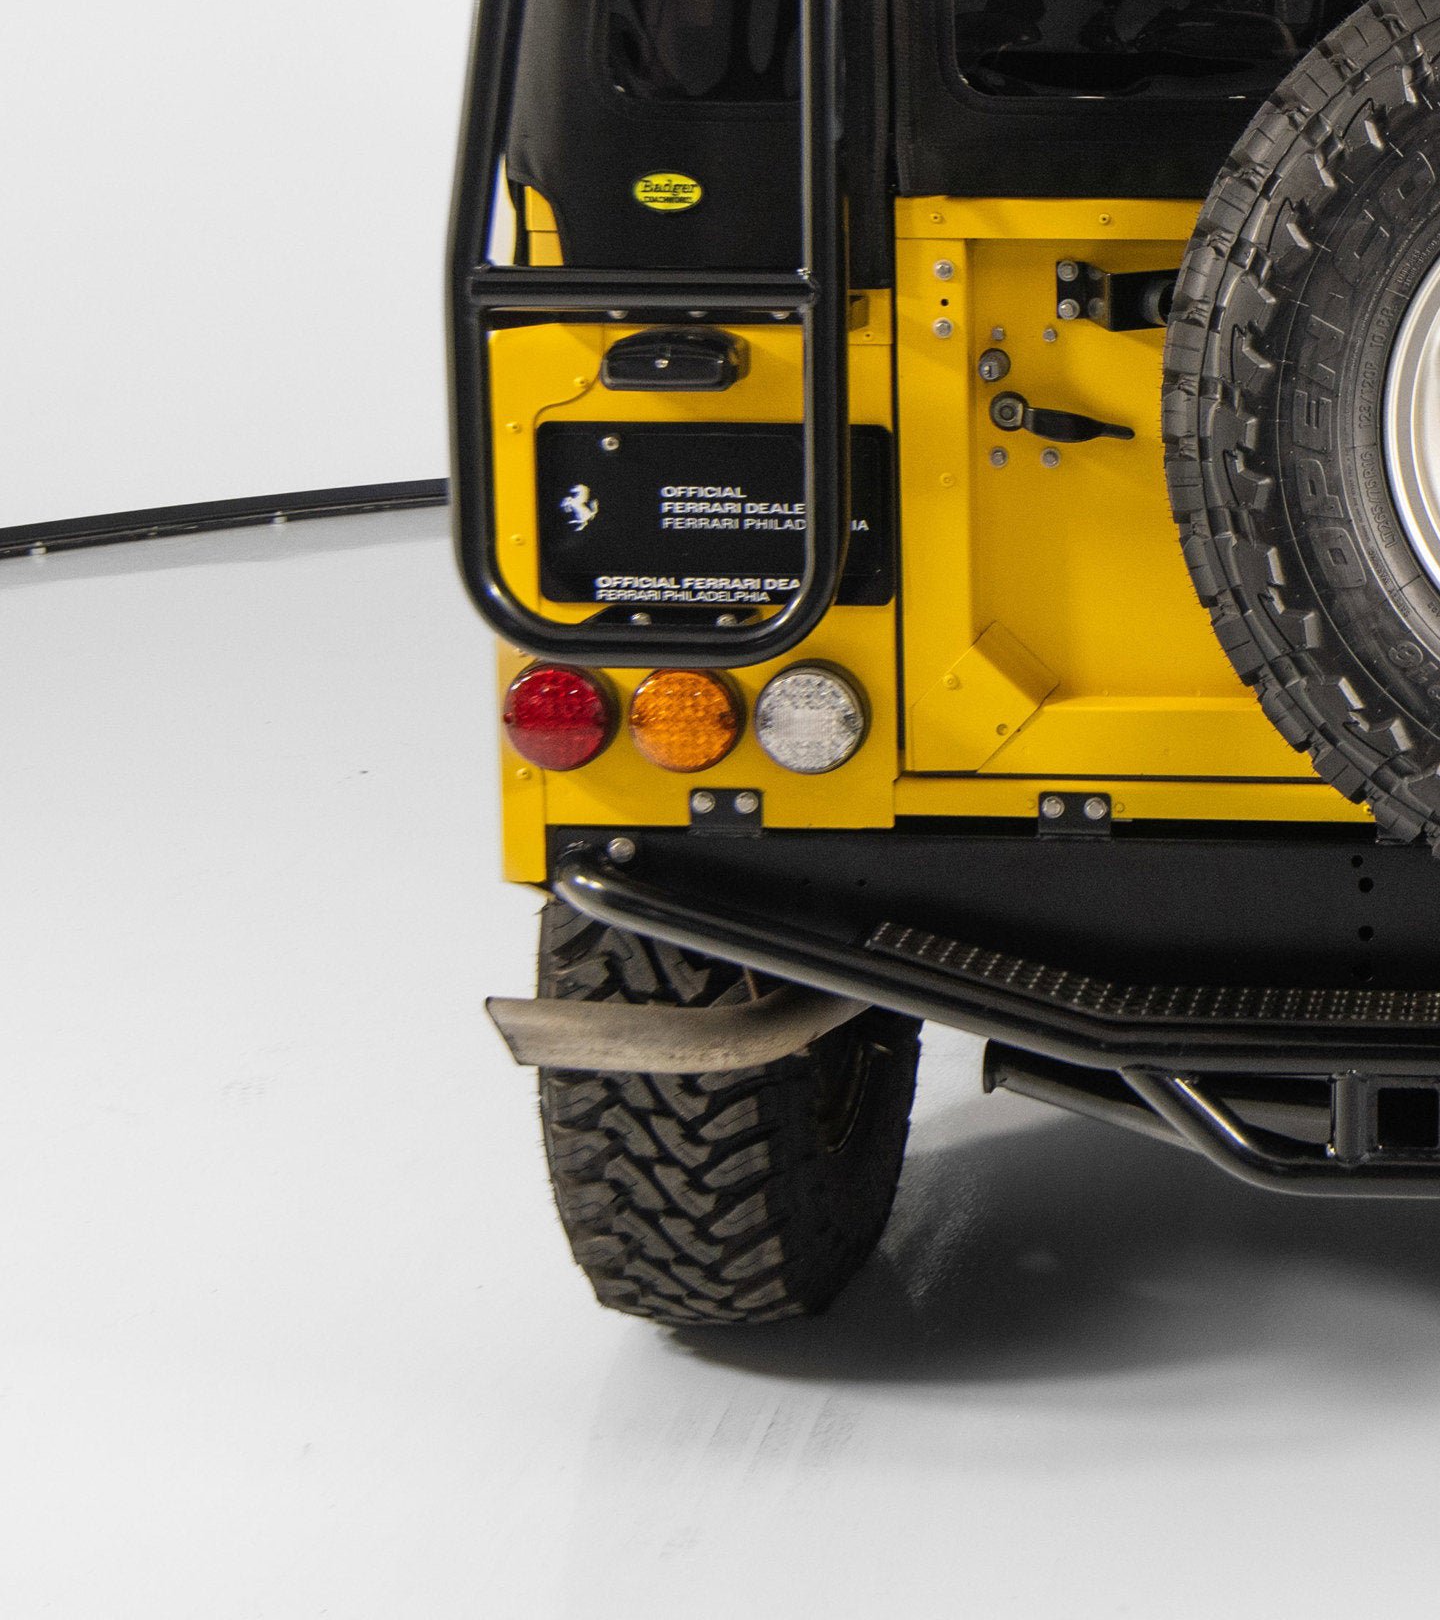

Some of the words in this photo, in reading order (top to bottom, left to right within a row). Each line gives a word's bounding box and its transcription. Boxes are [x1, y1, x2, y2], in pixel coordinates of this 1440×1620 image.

[641, 179, 698, 196] Badger
[661, 486, 747, 498] OFFICIAL
[662, 502, 741, 514] FERRARI
[744, 503, 806, 514] DEALE
[662, 518, 740, 530] FERRARI
[595, 576, 681, 589] OFFICIAL
[682, 578, 760, 590] FERRARI
[596, 589, 660, 601] FERRARI
[662, 590, 770, 602] PHILADELPHIA
